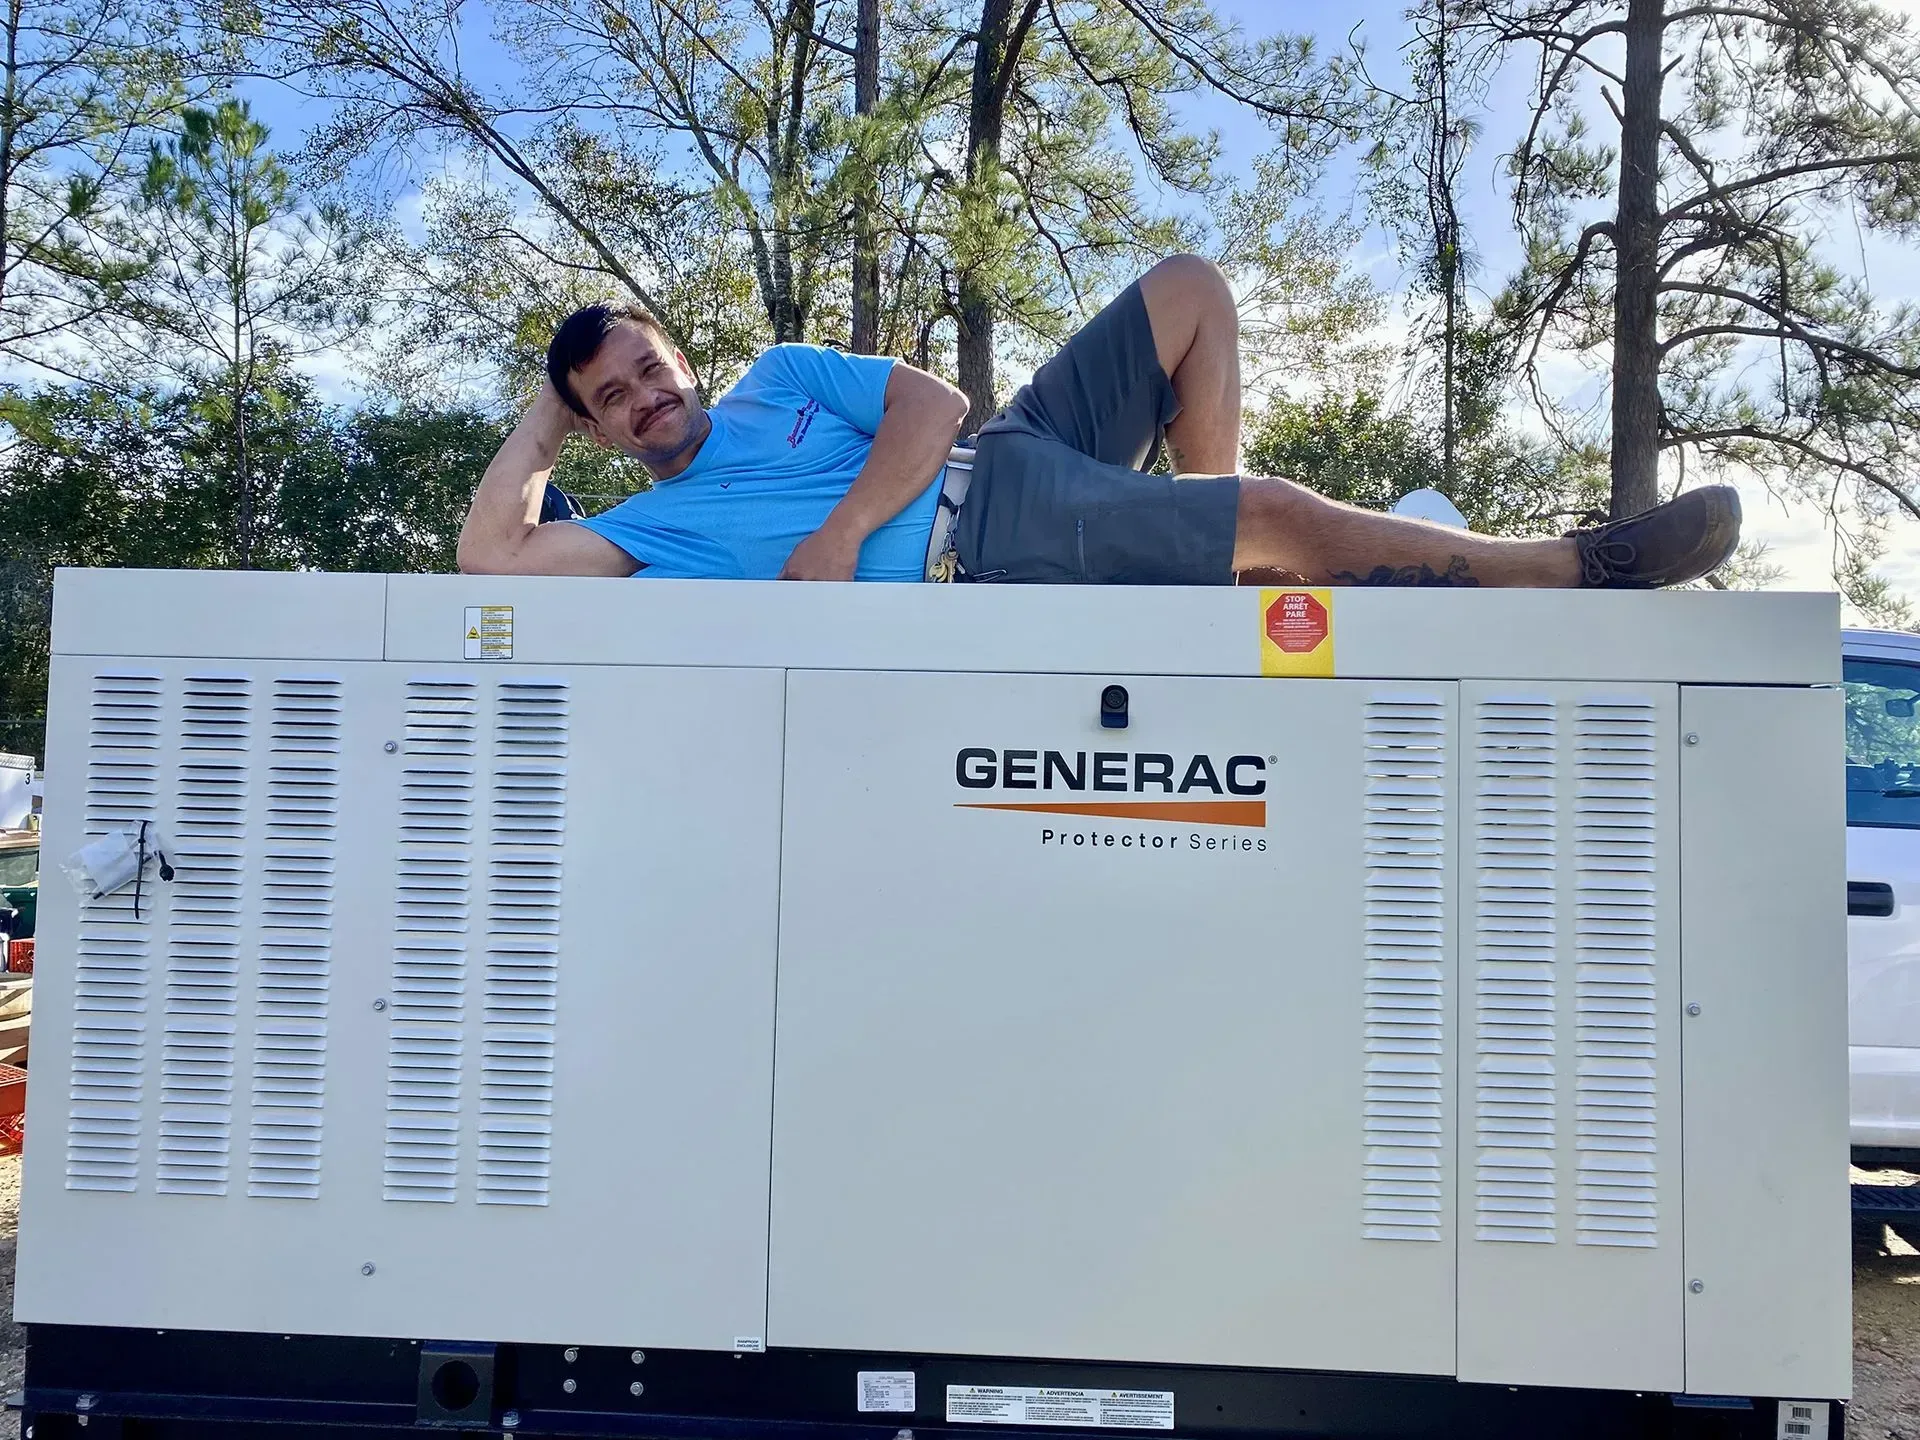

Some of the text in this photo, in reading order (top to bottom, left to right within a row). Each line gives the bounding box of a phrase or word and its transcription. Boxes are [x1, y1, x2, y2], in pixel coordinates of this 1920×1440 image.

[24, 772, 31, 785] 3
[955, 747, 1267, 796] GENERAC
[1042, 829, 1267, 852] Protector Series
